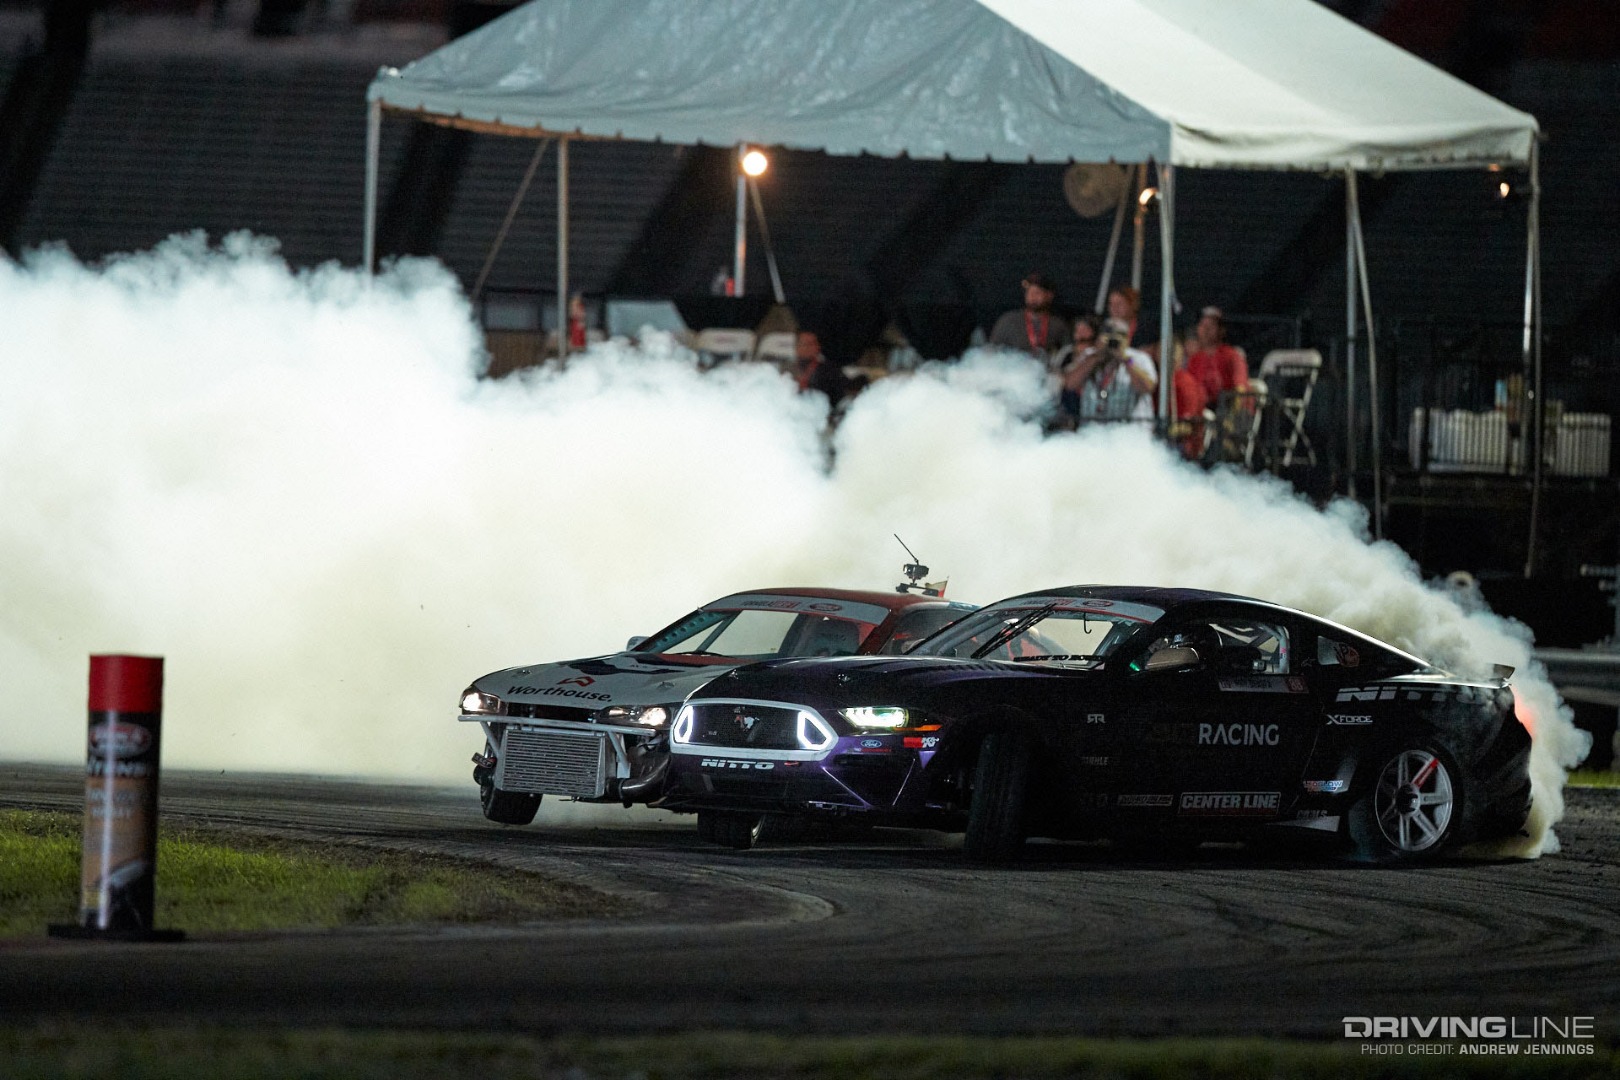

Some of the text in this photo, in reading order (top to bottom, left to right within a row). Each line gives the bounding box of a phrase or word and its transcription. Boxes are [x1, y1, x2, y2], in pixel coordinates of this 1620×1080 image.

[1198, 723, 1280, 746] RACING
[862, 740, 880, 748] Ford
[701, 758, 775, 770] NITTO
[1181, 794, 1241, 808] CENTER
[1244, 794, 1279, 808] LINE
